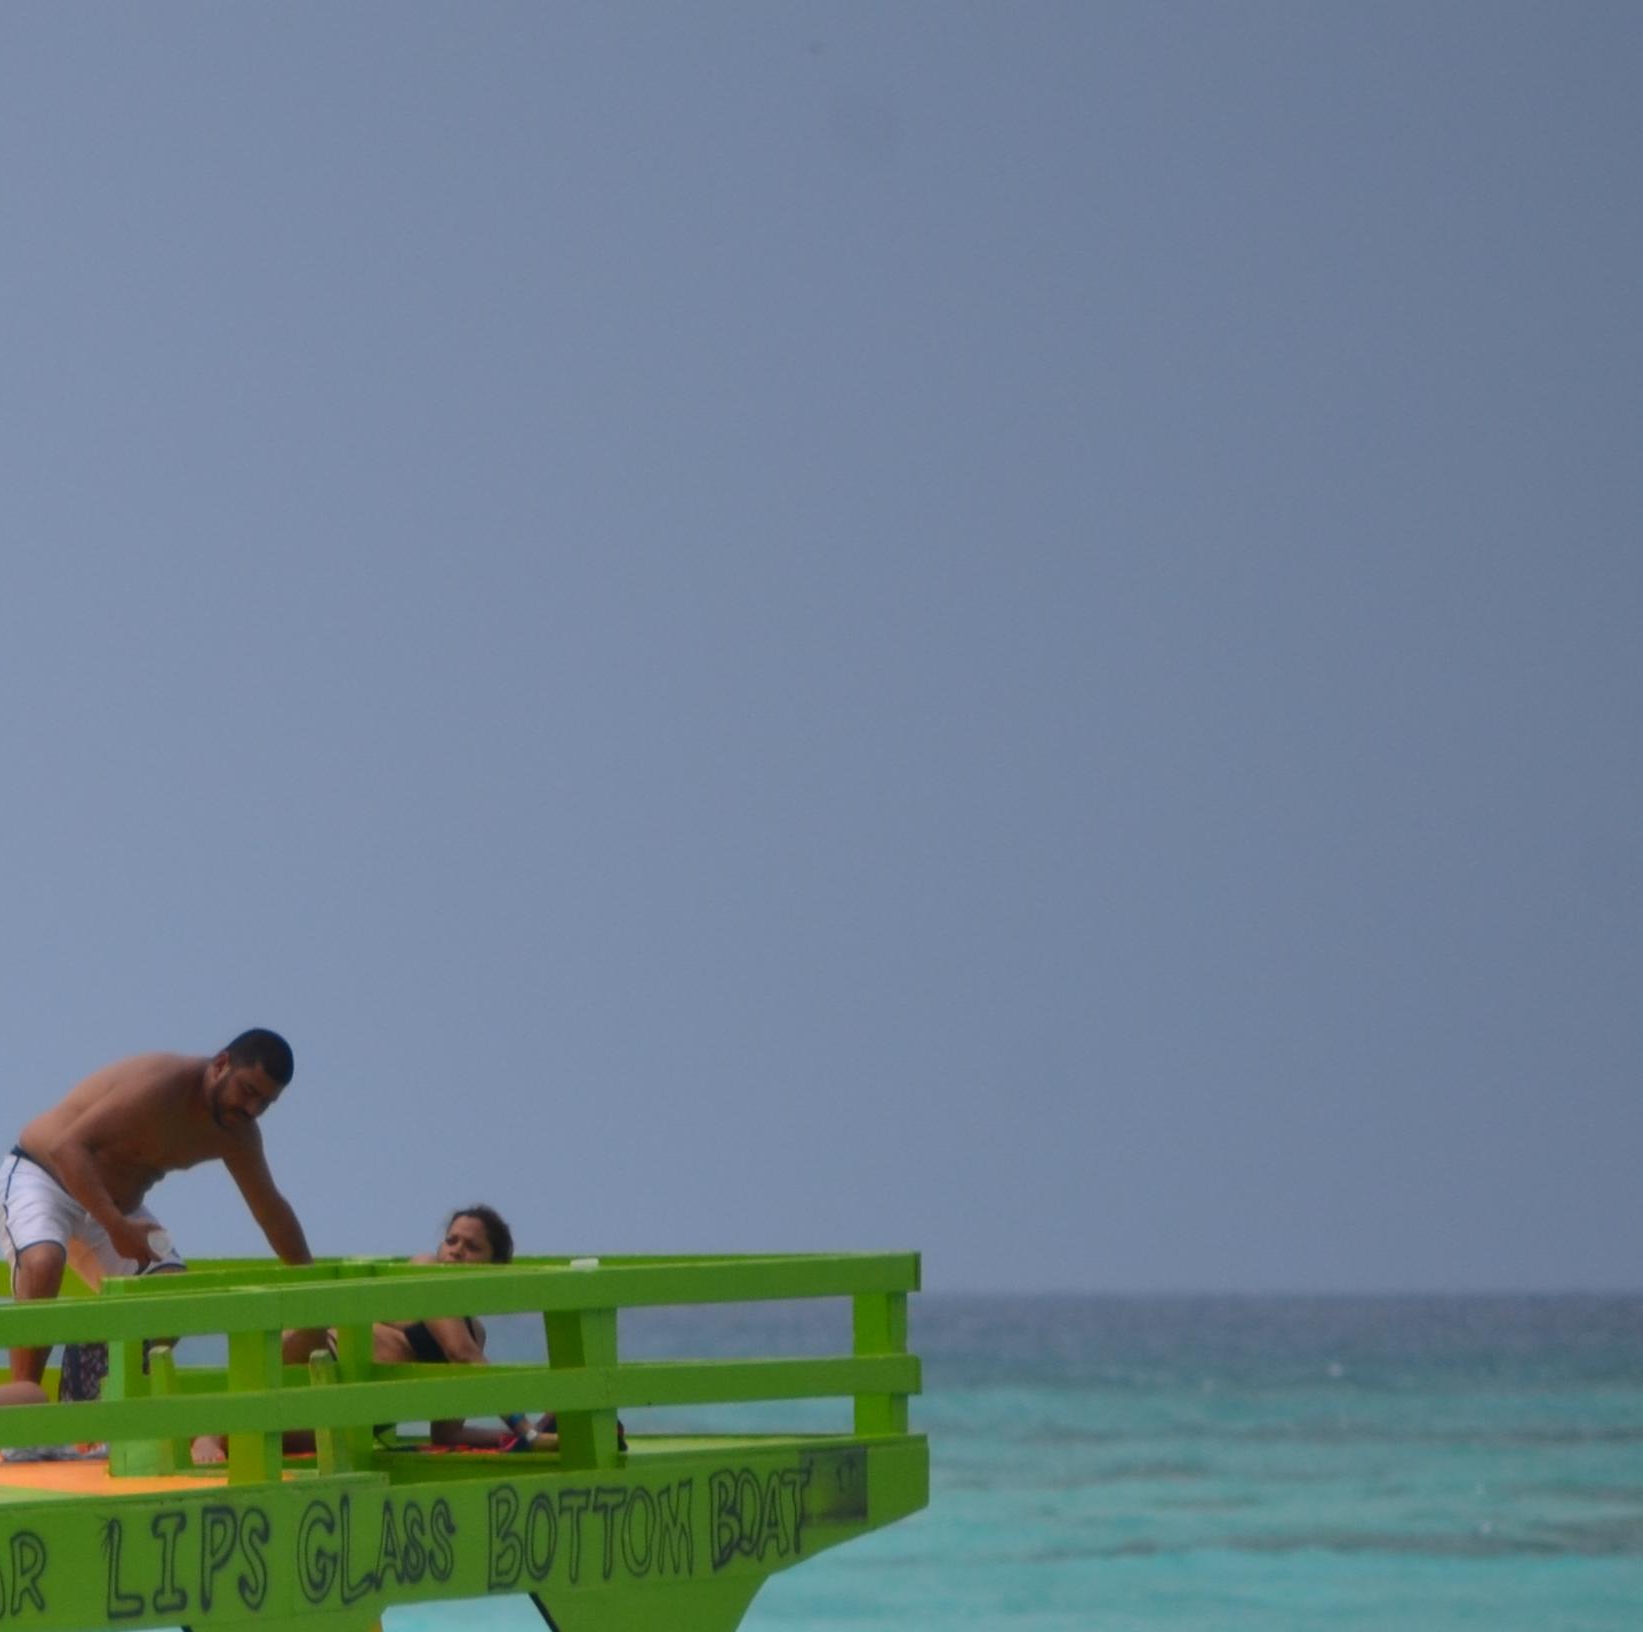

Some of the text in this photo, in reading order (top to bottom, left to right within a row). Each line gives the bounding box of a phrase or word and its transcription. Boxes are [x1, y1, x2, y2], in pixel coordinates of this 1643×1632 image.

[106, 1505, 271, 1620] LIPS
[296, 1493, 456, 1606] GLASS
[487, 1477, 694, 1590] BOTTOM
[708, 1466, 812, 1572] BOAT
